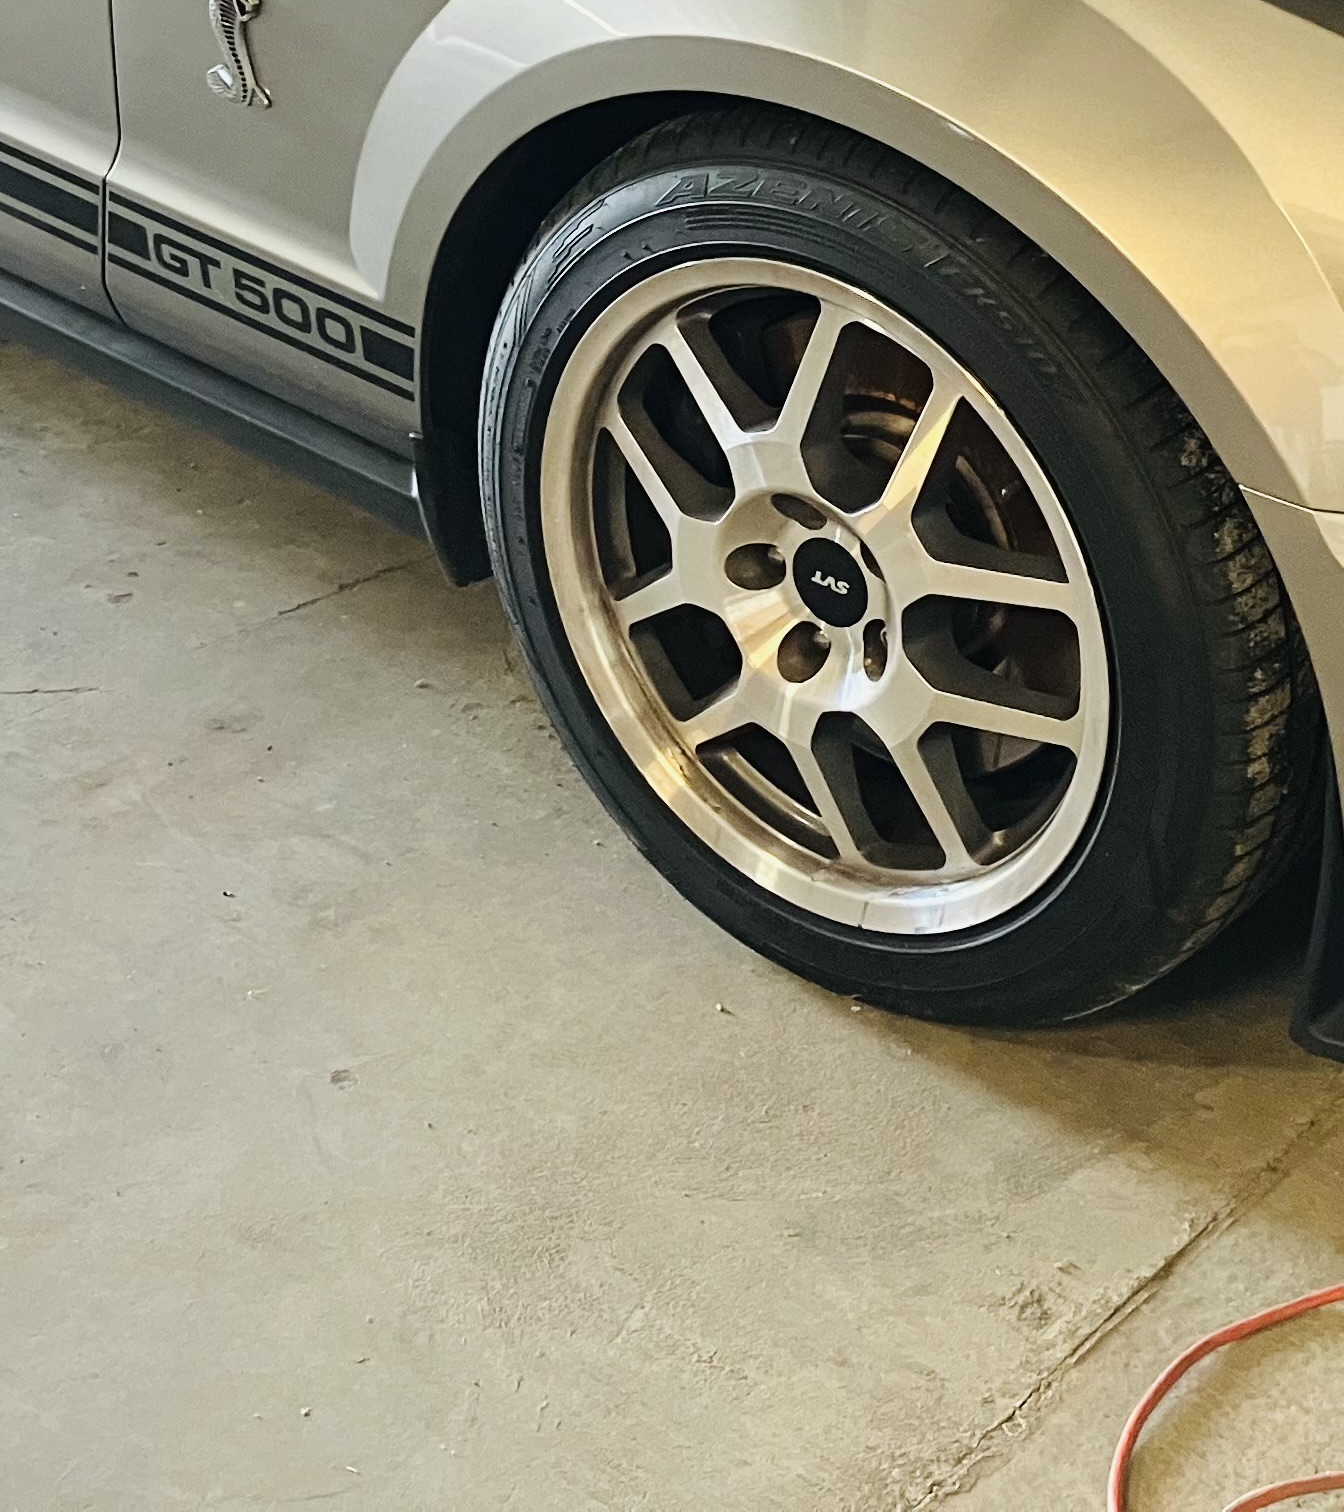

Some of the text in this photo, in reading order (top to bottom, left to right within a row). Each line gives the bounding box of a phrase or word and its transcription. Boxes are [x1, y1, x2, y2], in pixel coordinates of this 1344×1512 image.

[153, 233, 356, 354] GT 500
[811, 570, 850, 595] SVT
